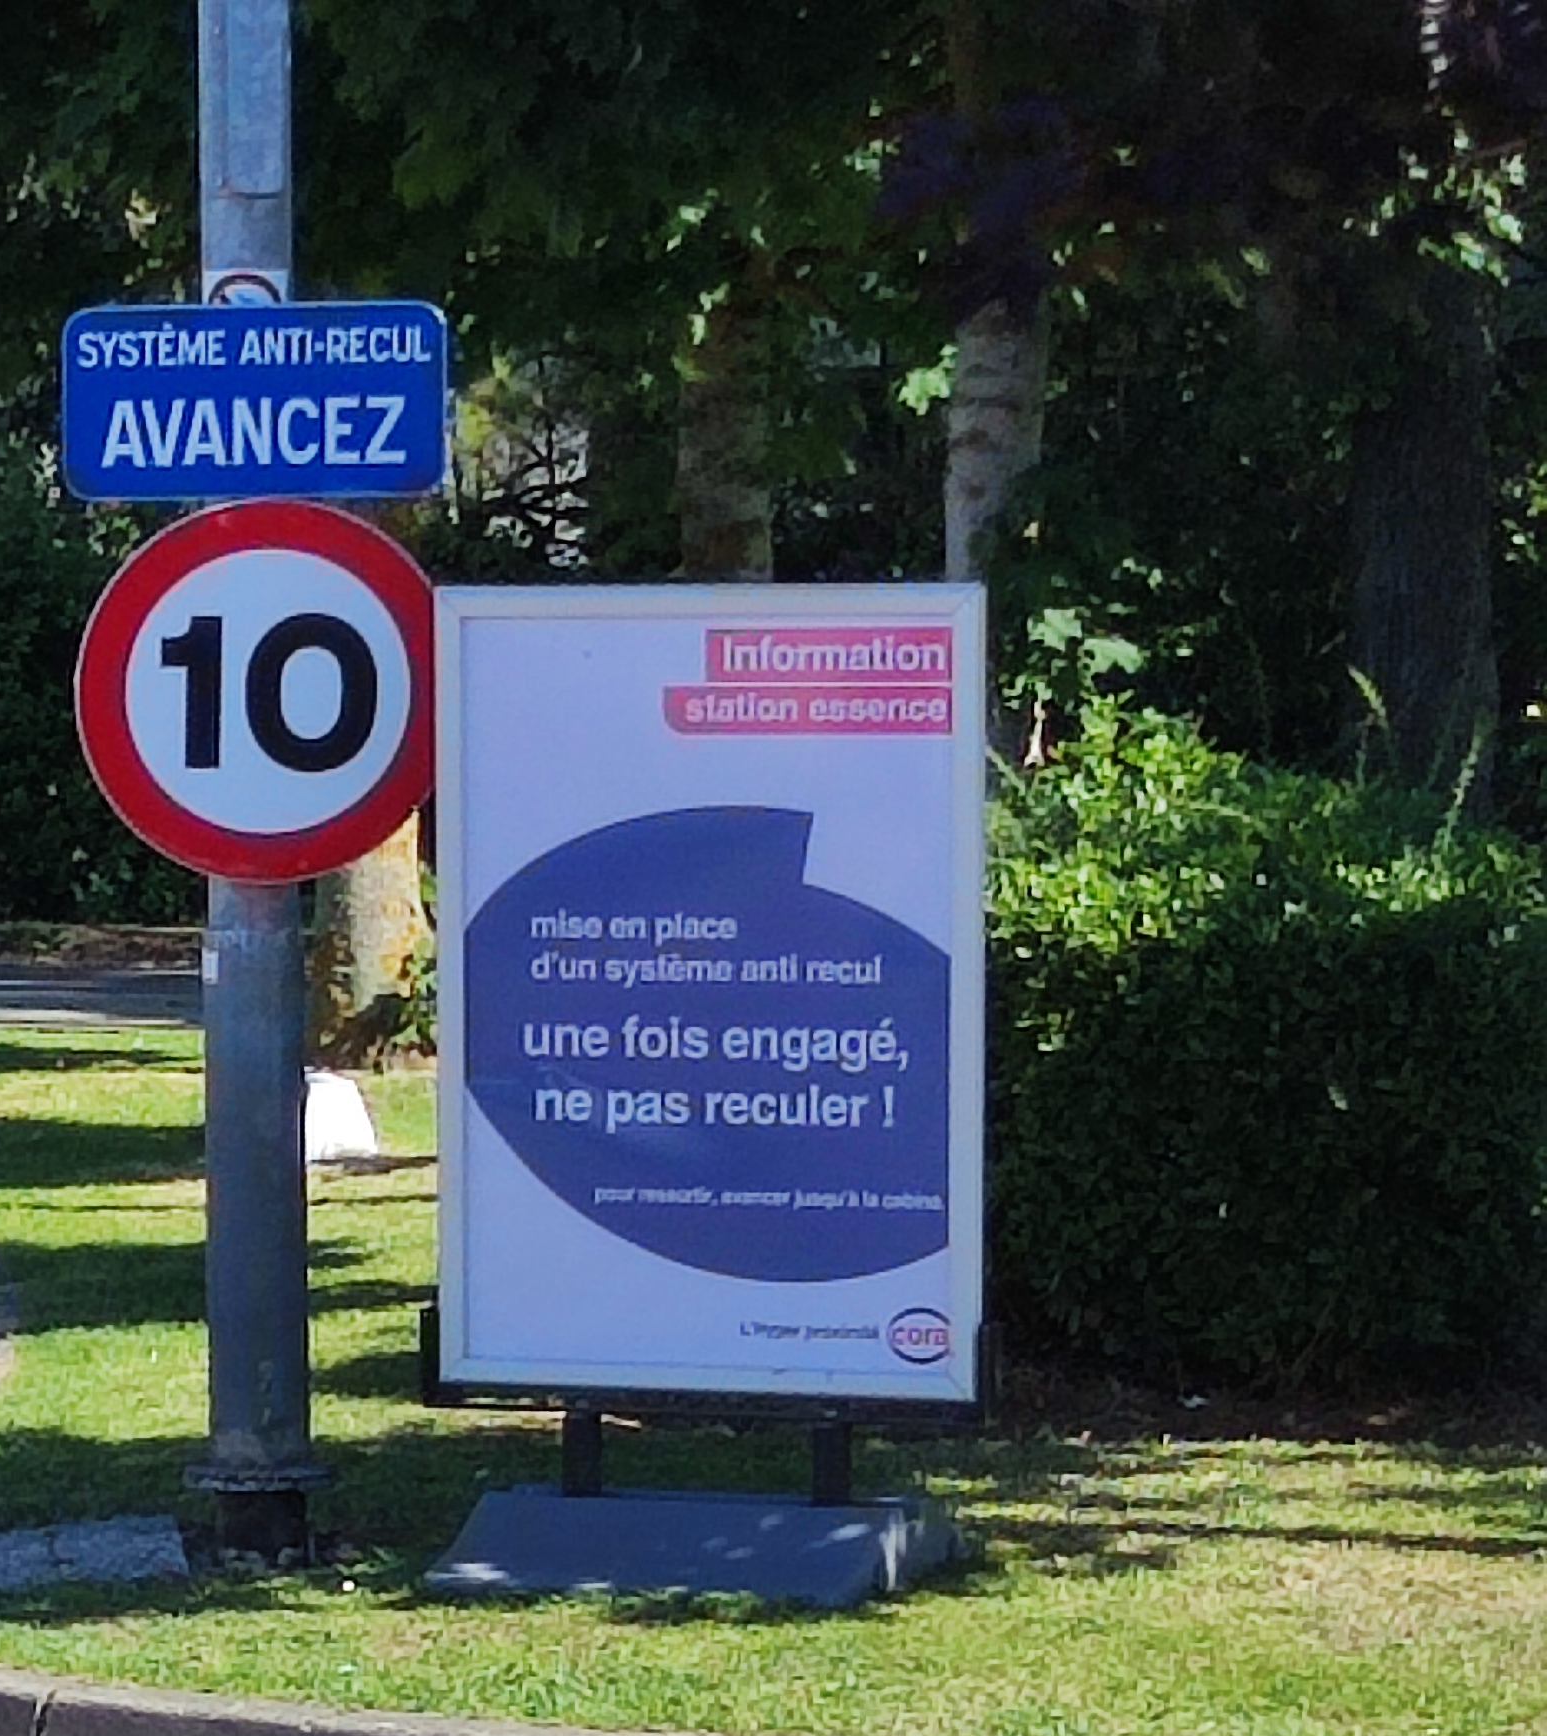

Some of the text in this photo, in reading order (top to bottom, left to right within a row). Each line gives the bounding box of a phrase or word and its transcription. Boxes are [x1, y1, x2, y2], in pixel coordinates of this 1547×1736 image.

[76, 322, 431, 368] SYSTÈME ANTI-RECUL
[101, 395, 406, 468] AVANCEZ
[722, 634, 945, 671] Information
[161, 612, 378, 773] 10
[685, 692, 947, 722] station essence
[531, 908, 738, 946] mise en place
[531, 951, 881, 988] d'un système anti recul
[524, 1014, 908, 1072] une fois engagé,
[535, 1084, 894, 1133] ne pas reculer !
[892, 1326, 949, 1346] cora
